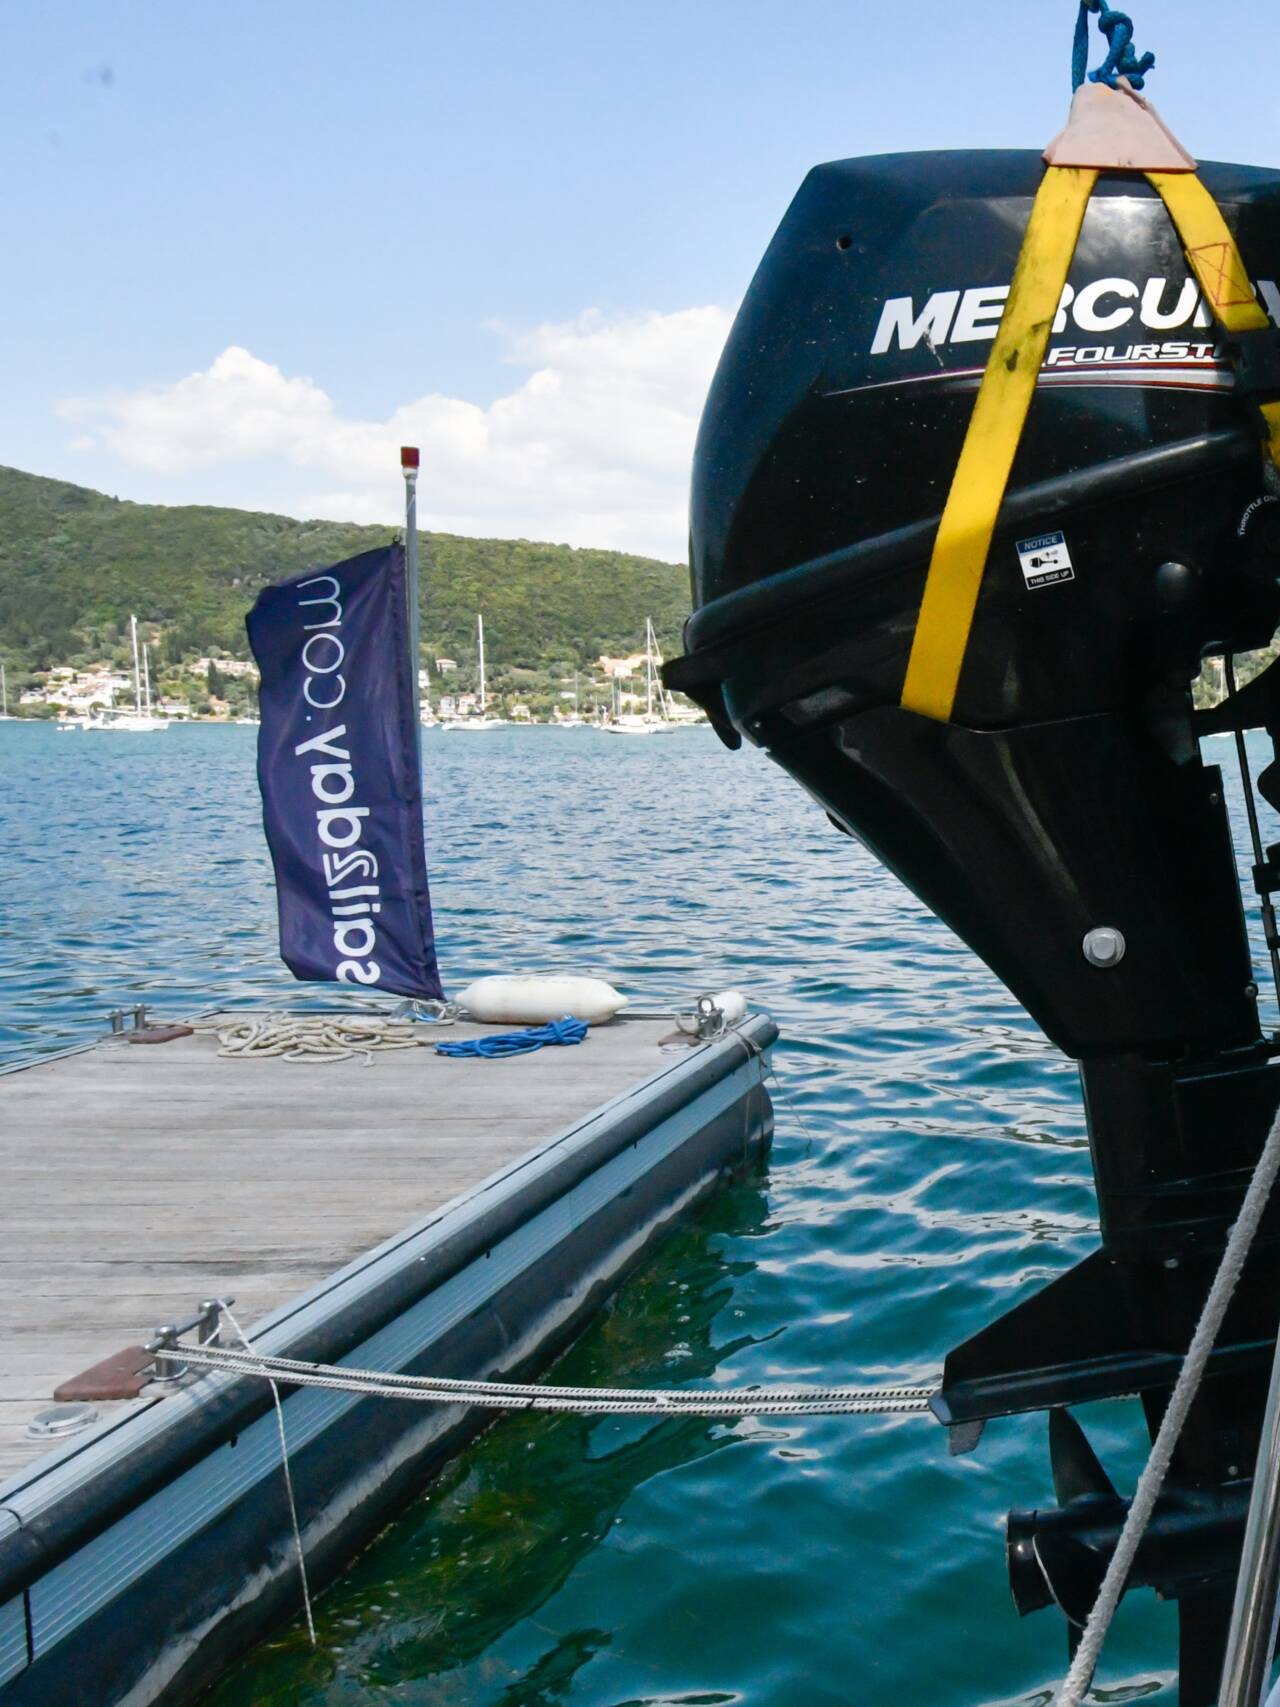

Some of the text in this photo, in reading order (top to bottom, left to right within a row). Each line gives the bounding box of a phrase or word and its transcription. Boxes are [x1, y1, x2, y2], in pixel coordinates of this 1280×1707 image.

[1024, 535, 1057, 550] NOTICE
[1030, 576, 1045, 585] THIS
[1060, 570, 1070, 578] UP
